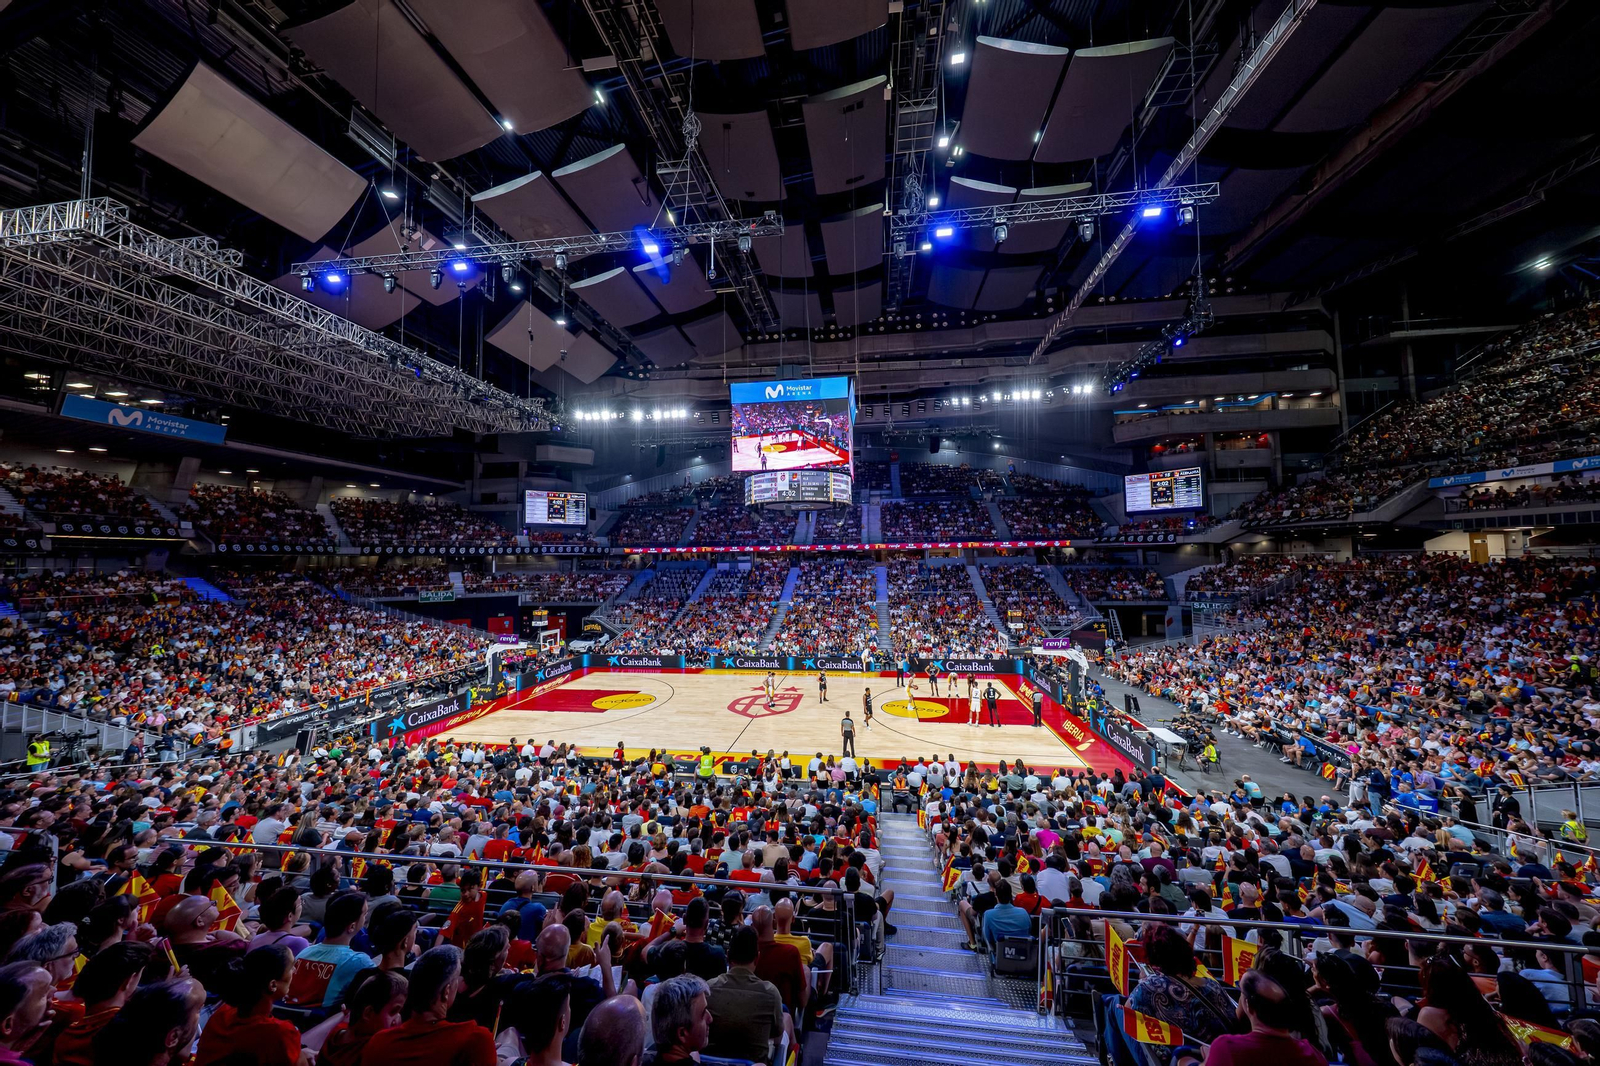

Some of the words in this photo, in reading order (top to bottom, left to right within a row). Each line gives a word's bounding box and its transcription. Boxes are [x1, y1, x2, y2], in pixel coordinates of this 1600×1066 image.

[147, 416, 189, 430] Movistar
[145, 424, 186, 435] ARENA
[1193, 602, 1230, 610] SALIDA
[500, 635, 517, 643] renfe
[1045, 640, 1068, 649] renfe
[620, 657, 662, 667] CaixaBank
[736, 658, 780, 669] CaixaBank
[817, 659, 863, 670] CaixaBank
[945, 661, 995, 672] CaixaBank
[545, 662, 573, 679] CaixaBank
[408, 700, 460, 727] CaixaBank
[885, 703, 946, 714] endesa
[286, 714, 309, 725] endesa
[1062, 719, 1085, 743] IBERIA
[1106, 723, 1146, 765] CaixaBank
